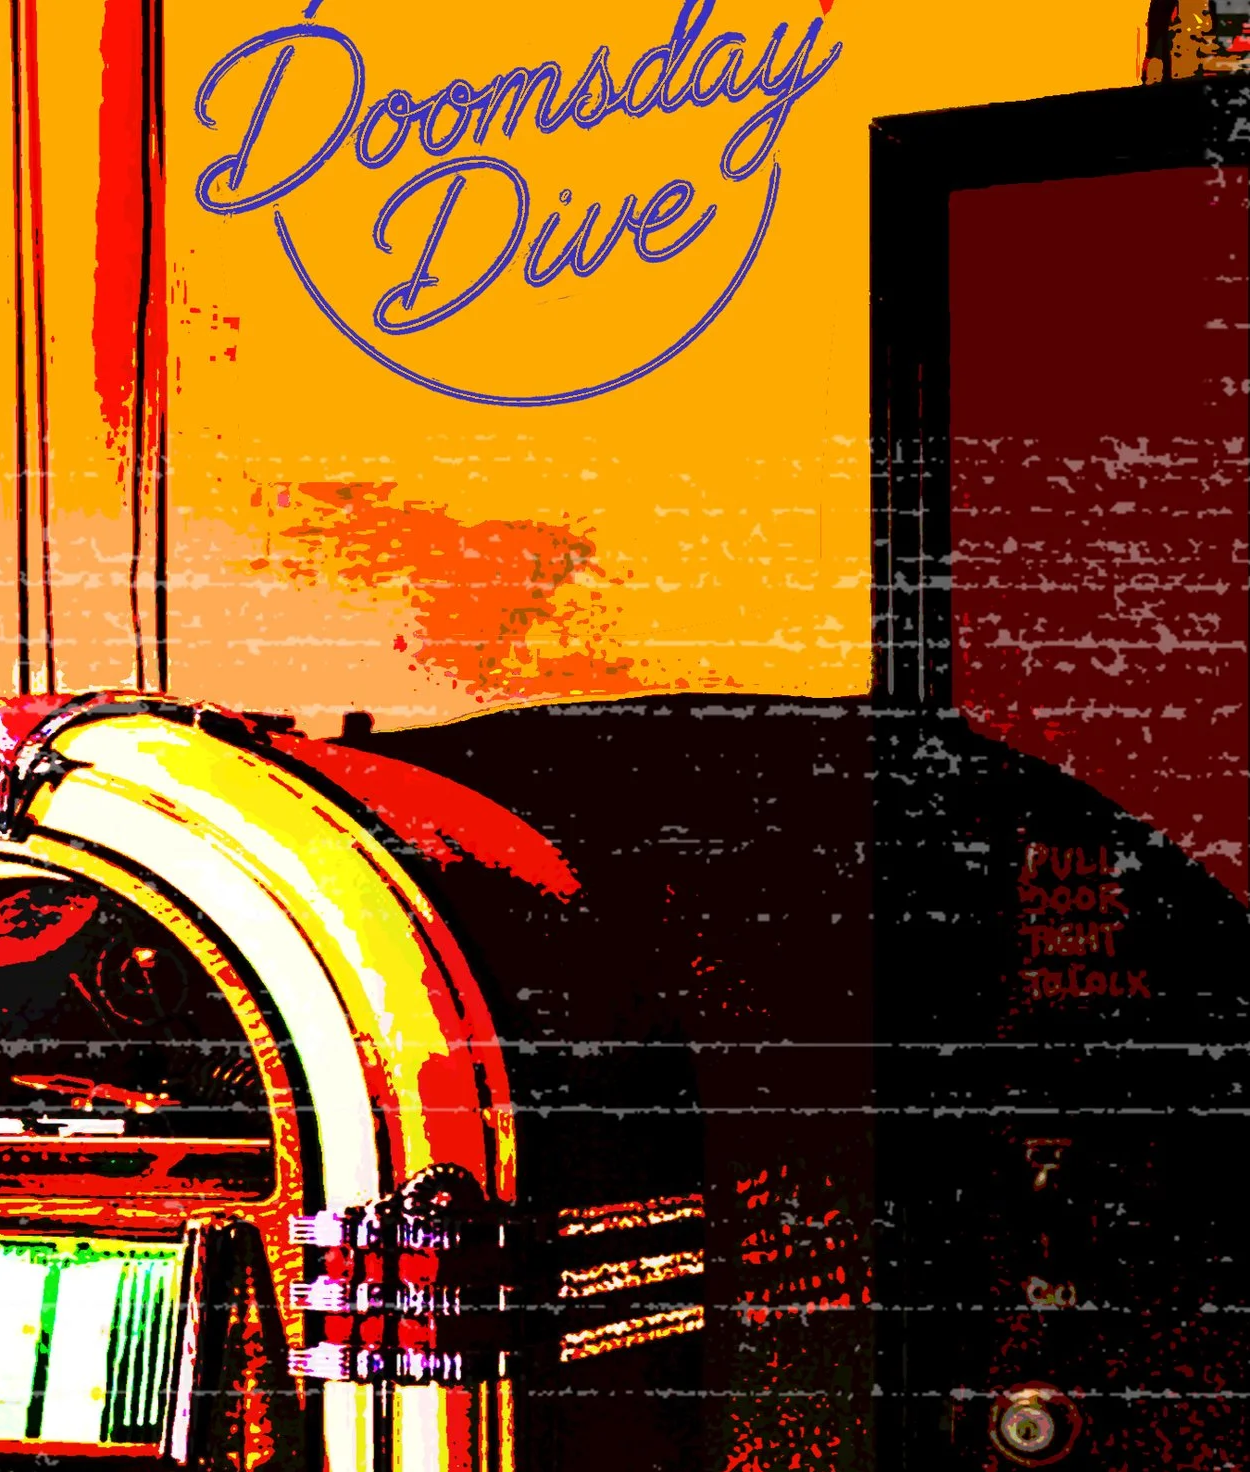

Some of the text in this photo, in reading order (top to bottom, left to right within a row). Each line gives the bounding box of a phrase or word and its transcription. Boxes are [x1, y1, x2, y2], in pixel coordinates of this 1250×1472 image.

[195, 0, 844, 214] Doomsday
[372, 155, 717, 335] Dive
[1017, 883, 1130, 915] DOOR
[1019, 843, 1124, 881] PULL
